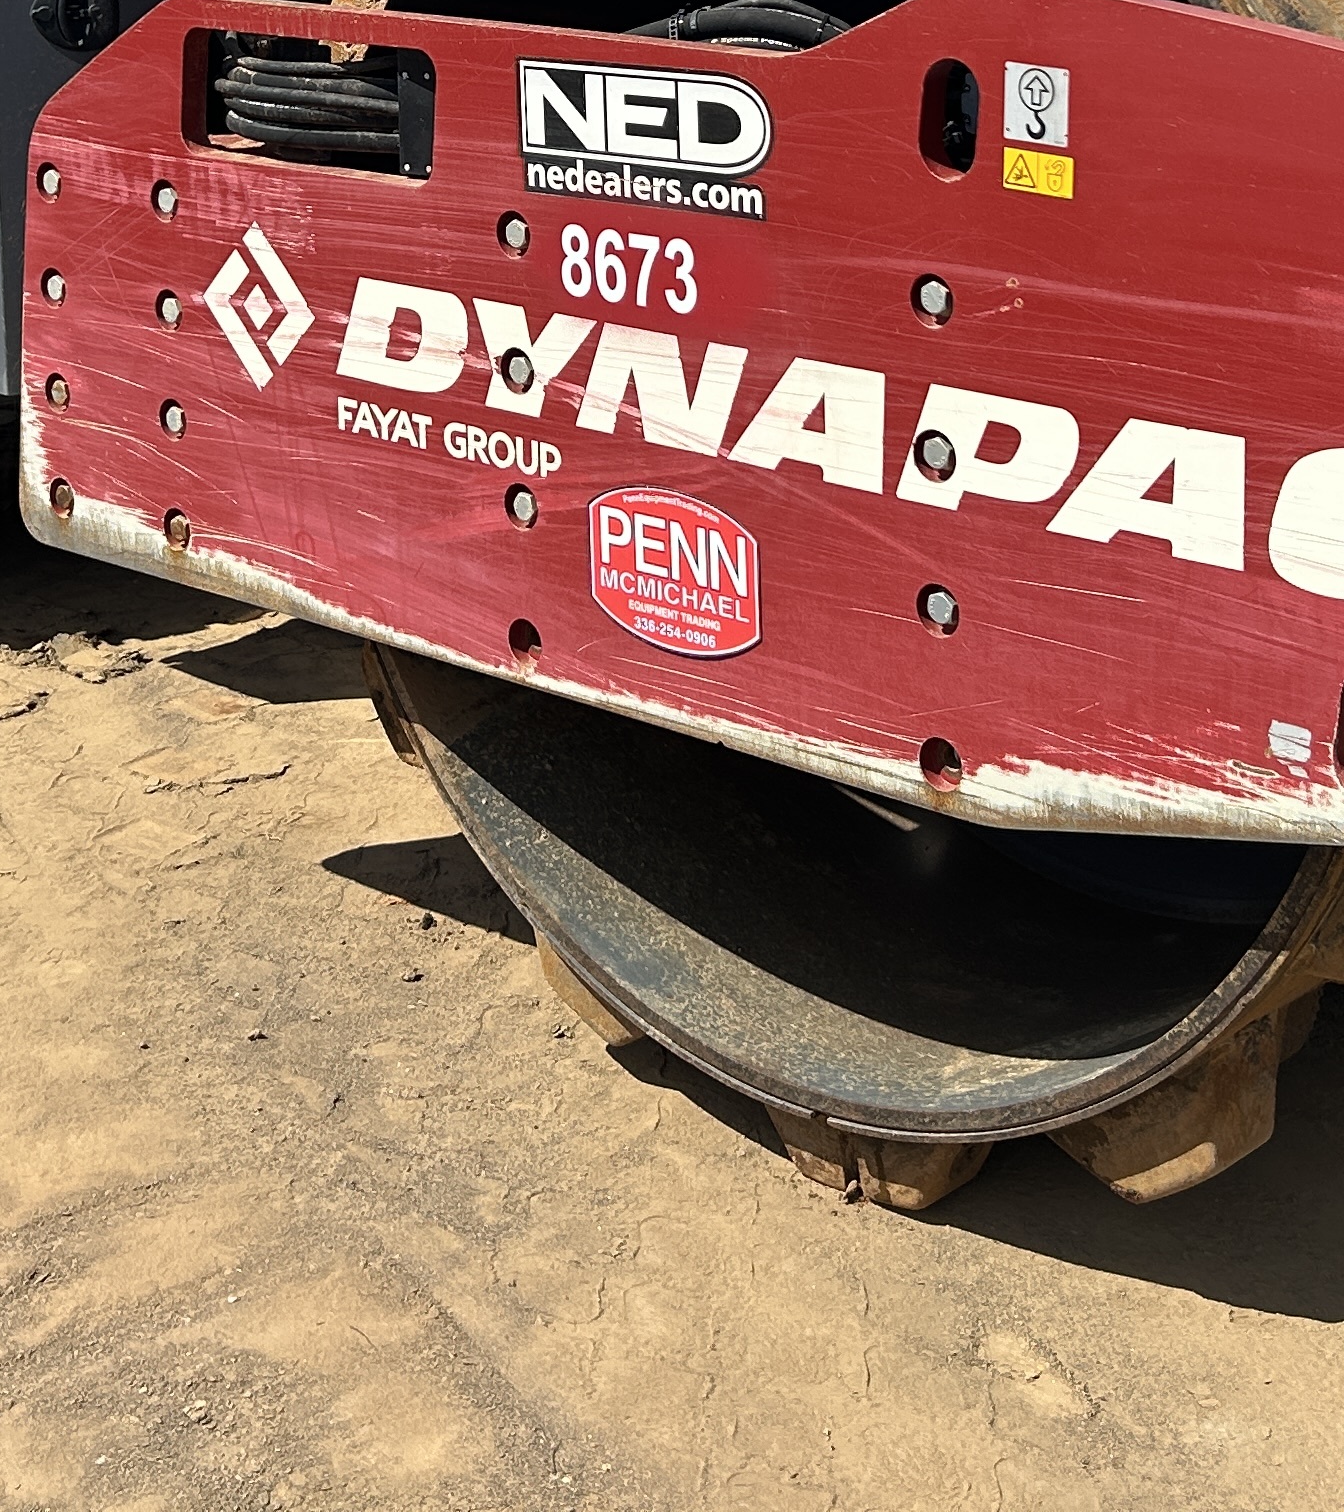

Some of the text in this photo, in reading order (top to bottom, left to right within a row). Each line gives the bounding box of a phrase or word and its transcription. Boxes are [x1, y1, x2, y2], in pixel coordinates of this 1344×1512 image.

[525, 67, 767, 165] NED
[527, 159, 764, 216] nedealers.com
[560, 223, 698, 315] 8673
[337, 396, 562, 478] FAYAT GROUP
[599, 504, 748, 599] PENN
[599, 566, 750, 624] MCMICHAEL
[628, 598, 722, 632] EQUIPMENT TRADING
[633, 615, 717, 649] 336-254-0906
